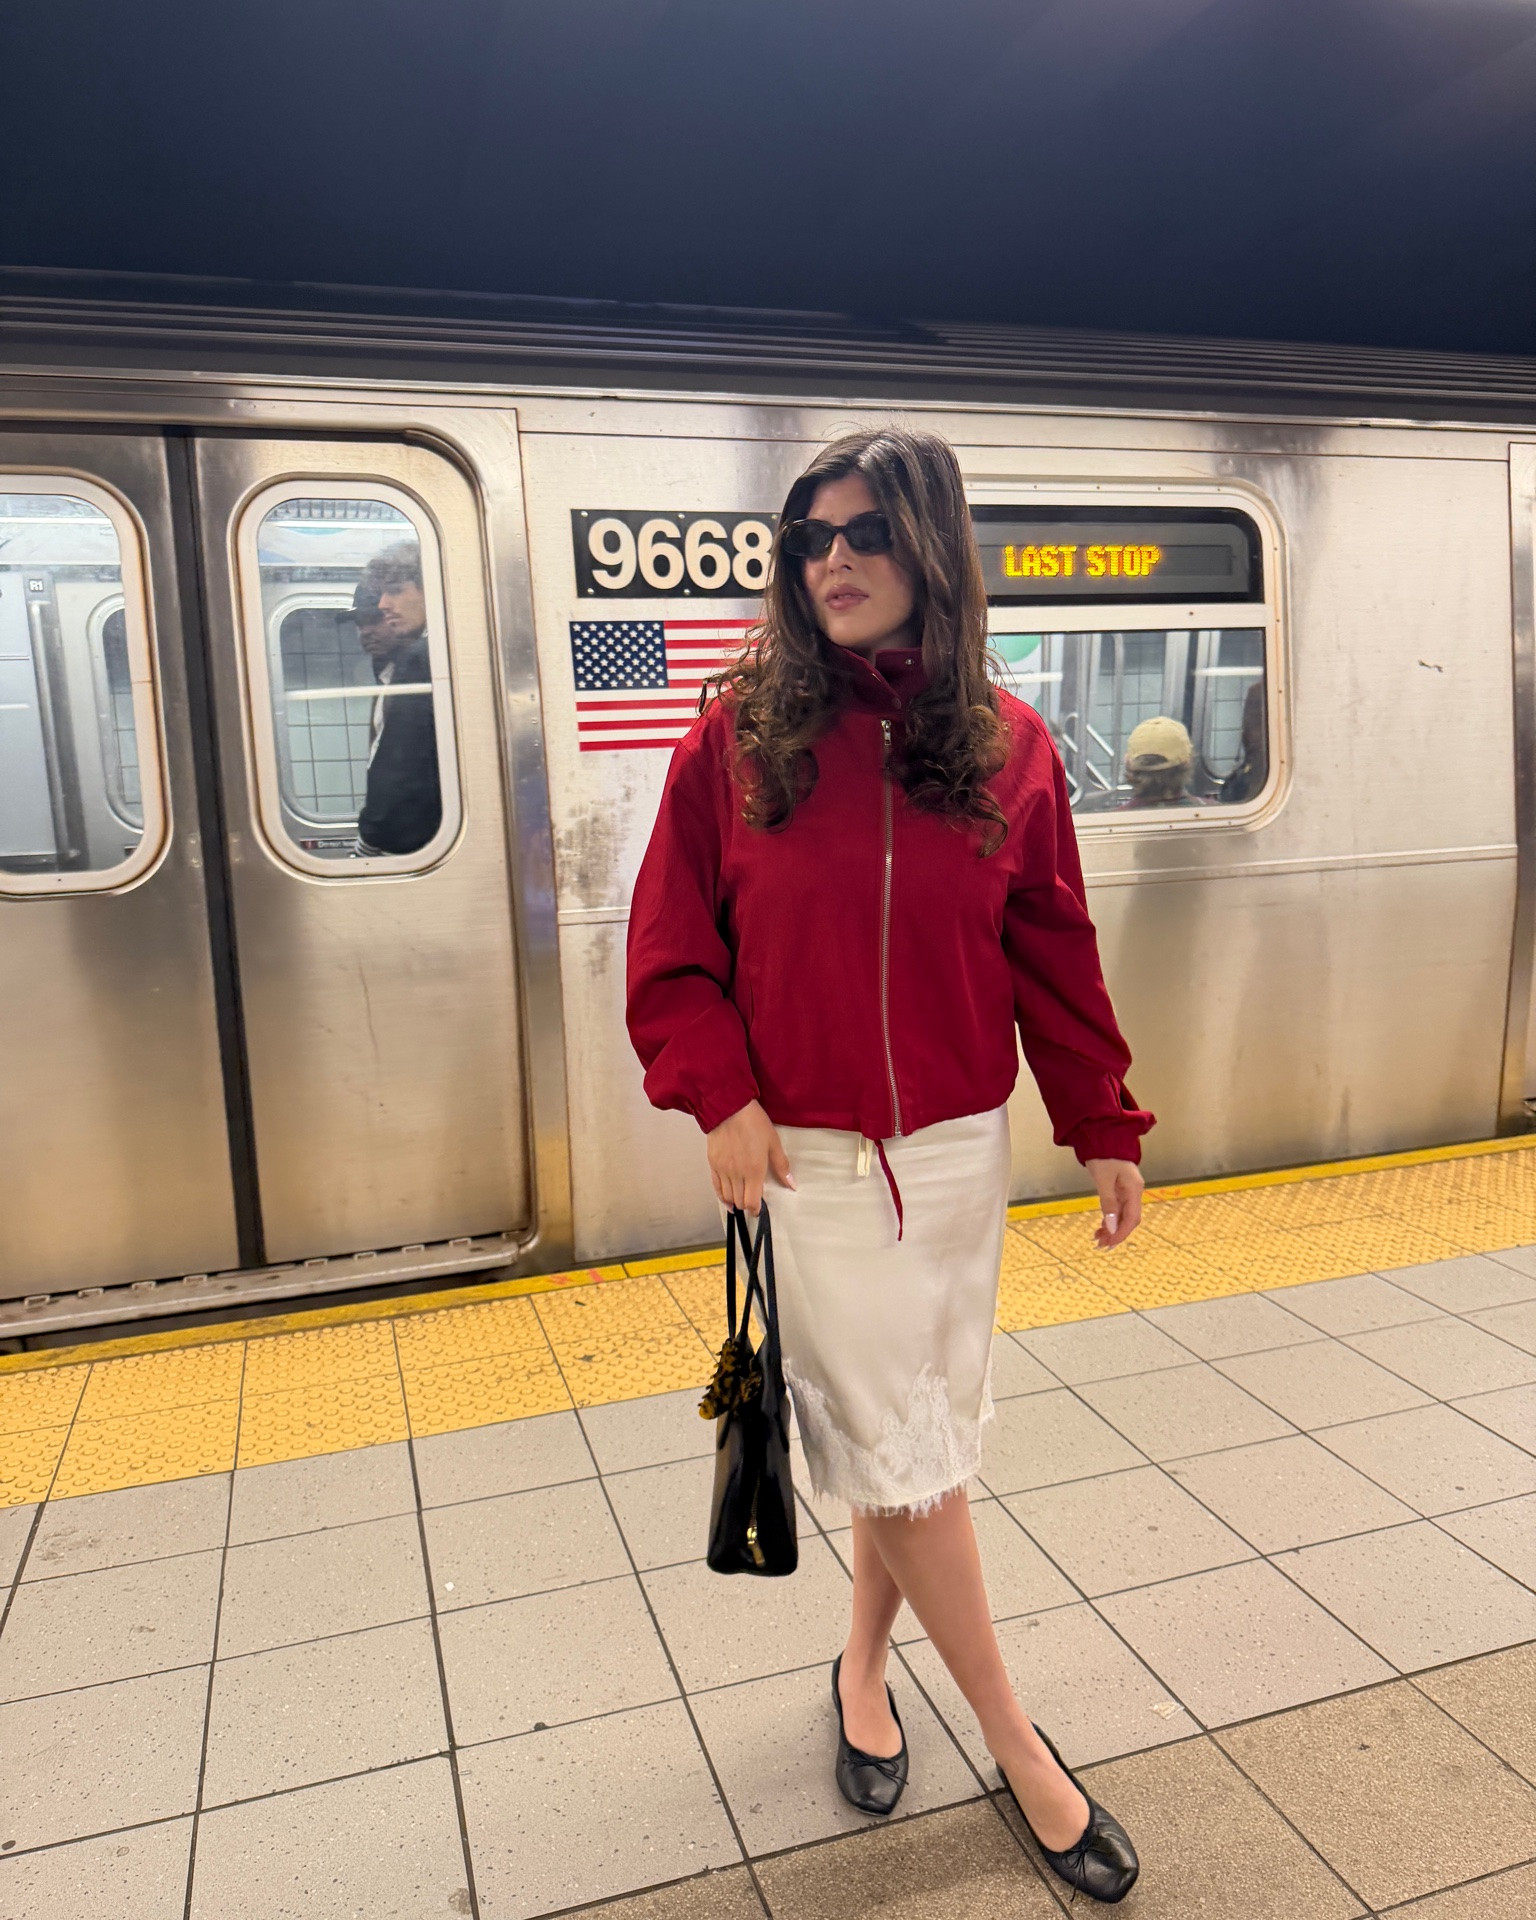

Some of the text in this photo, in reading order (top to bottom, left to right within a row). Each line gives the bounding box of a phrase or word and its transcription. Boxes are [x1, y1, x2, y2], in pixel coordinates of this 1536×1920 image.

[588, 517, 773, 590] 9668
[1004, 544, 1161, 578] LAST STOP
